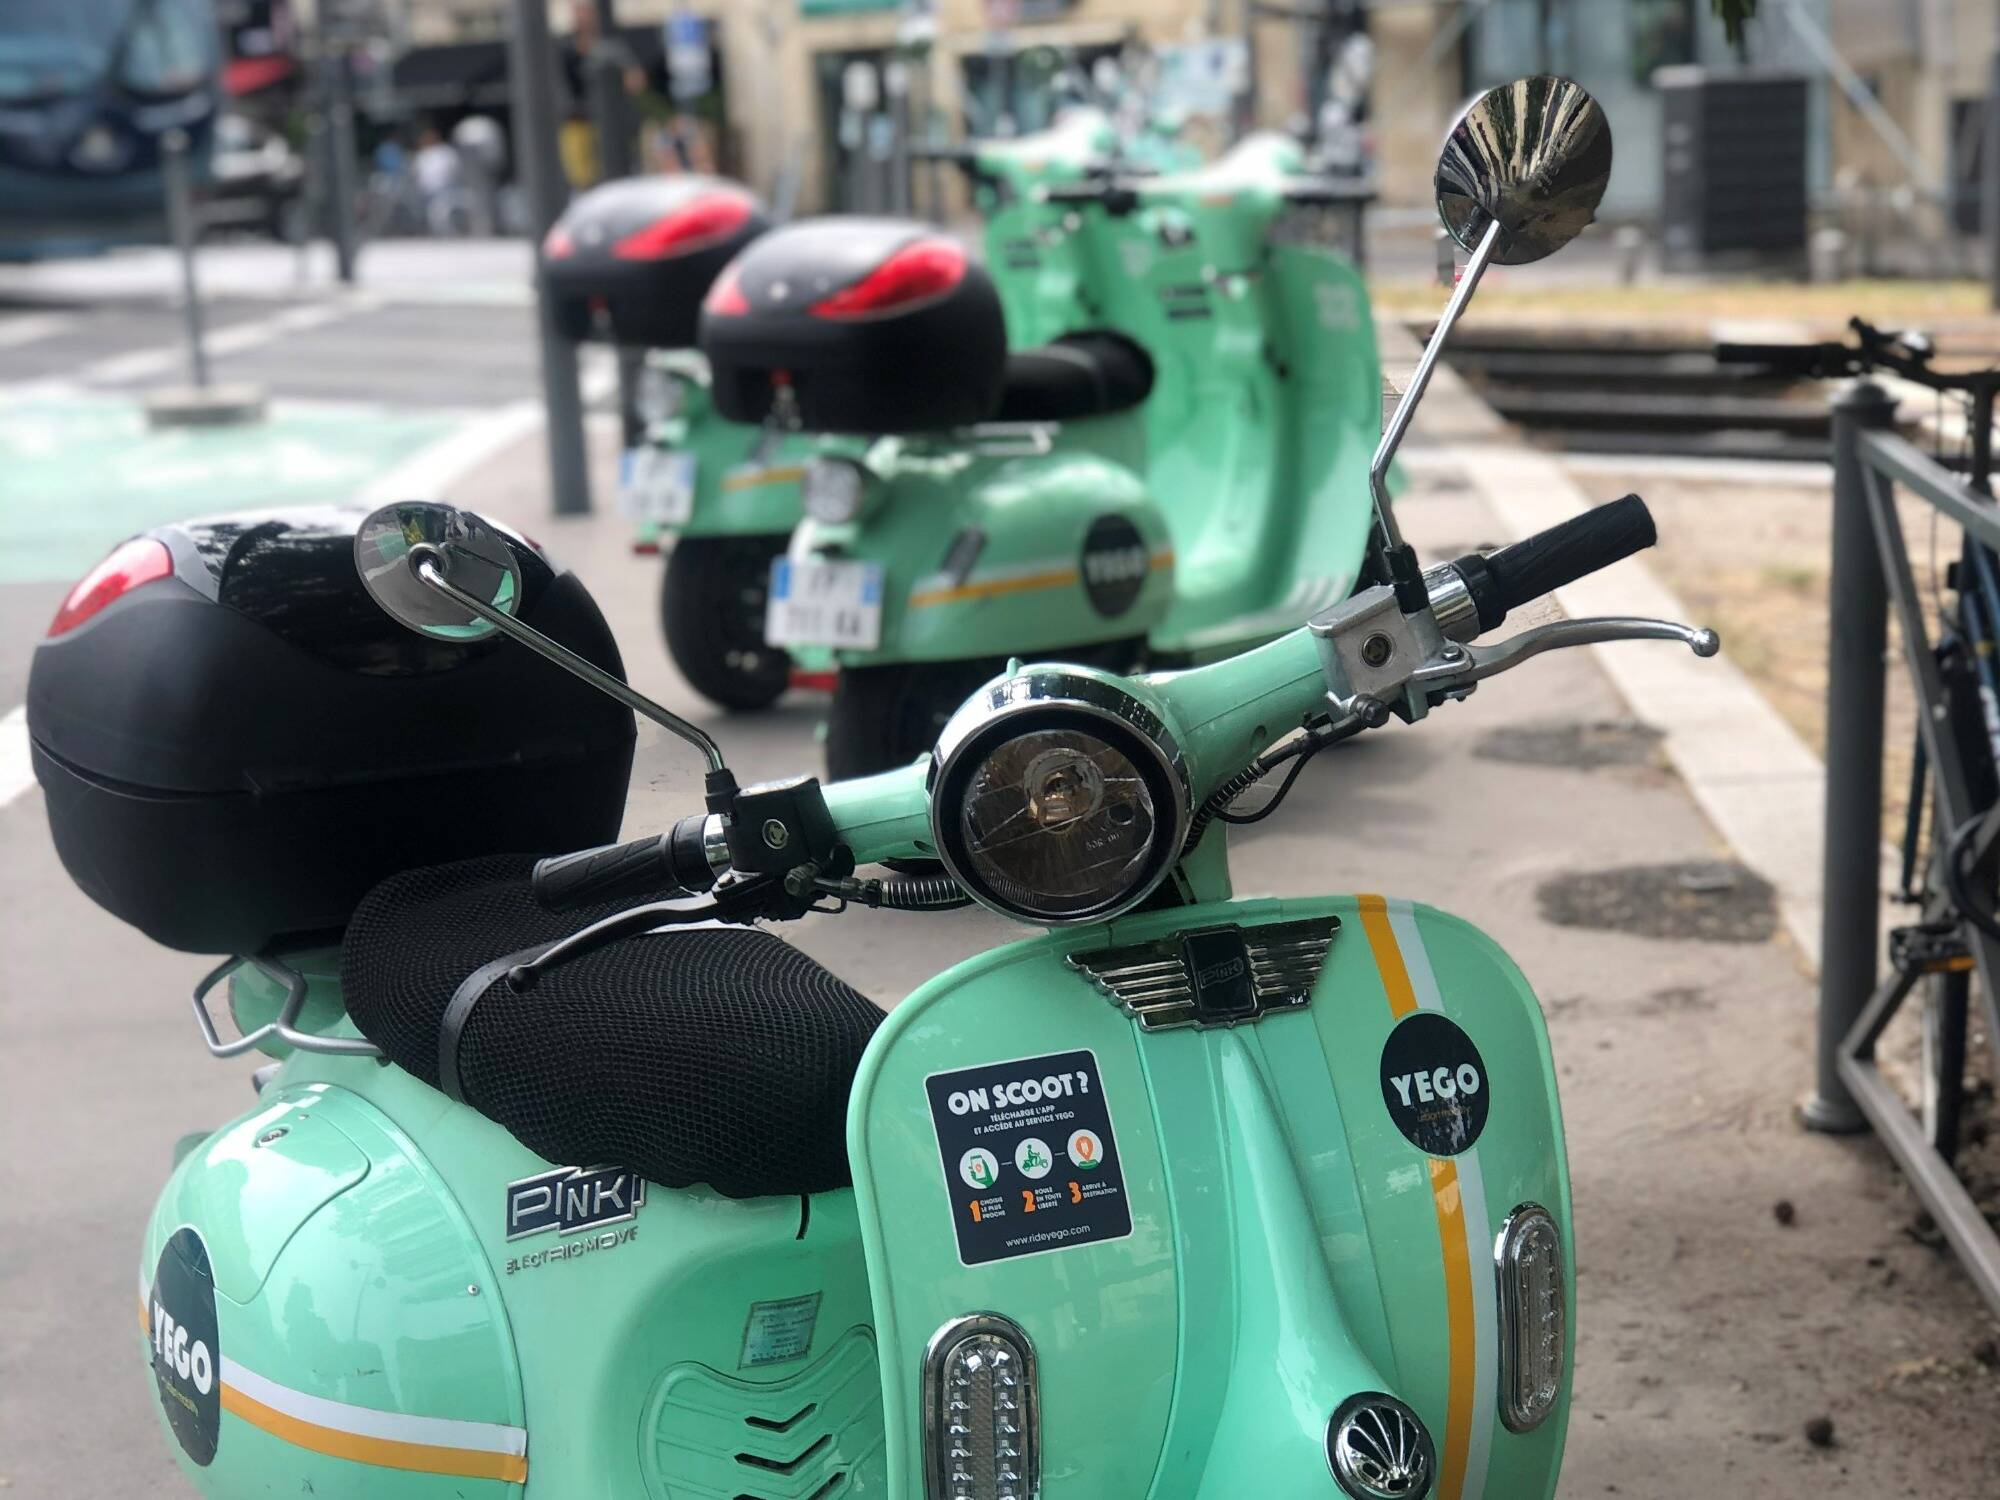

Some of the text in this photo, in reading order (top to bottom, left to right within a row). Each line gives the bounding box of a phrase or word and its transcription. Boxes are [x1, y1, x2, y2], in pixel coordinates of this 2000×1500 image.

[947, 1087, 990, 1115] ON
[992, 1073, 1074, 1108] SCOOT
[1390, 1063, 1480, 1107] YEGO
[973, 1127, 982, 1136] ET
[1014, 1119, 1025, 1128] AU
[1026, 1115, 1055, 1126] SERVICE
[1055, 1111, 1075, 1121] YEGO
[990, 1105, 1055, 1123] TÉLÉCHARGE L'APP
[512, 1174, 627, 1227] PINK
[1021, 1190, 1036, 1213] 2
[1034, 1186, 1053, 1195] ROULE
[1044, 1192, 1062, 1201] TOUTE
[1068, 1181, 1082, 1204] 3
[1082, 1187, 1118, 1199] DESTINATION
[969, 1200, 982, 1222] 1
[982, 1210, 1006, 1220] PROCHE
[1005, 1225, 1091, 1247] www.rideyego.com
[153, 1300, 213, 1395] YEGO
